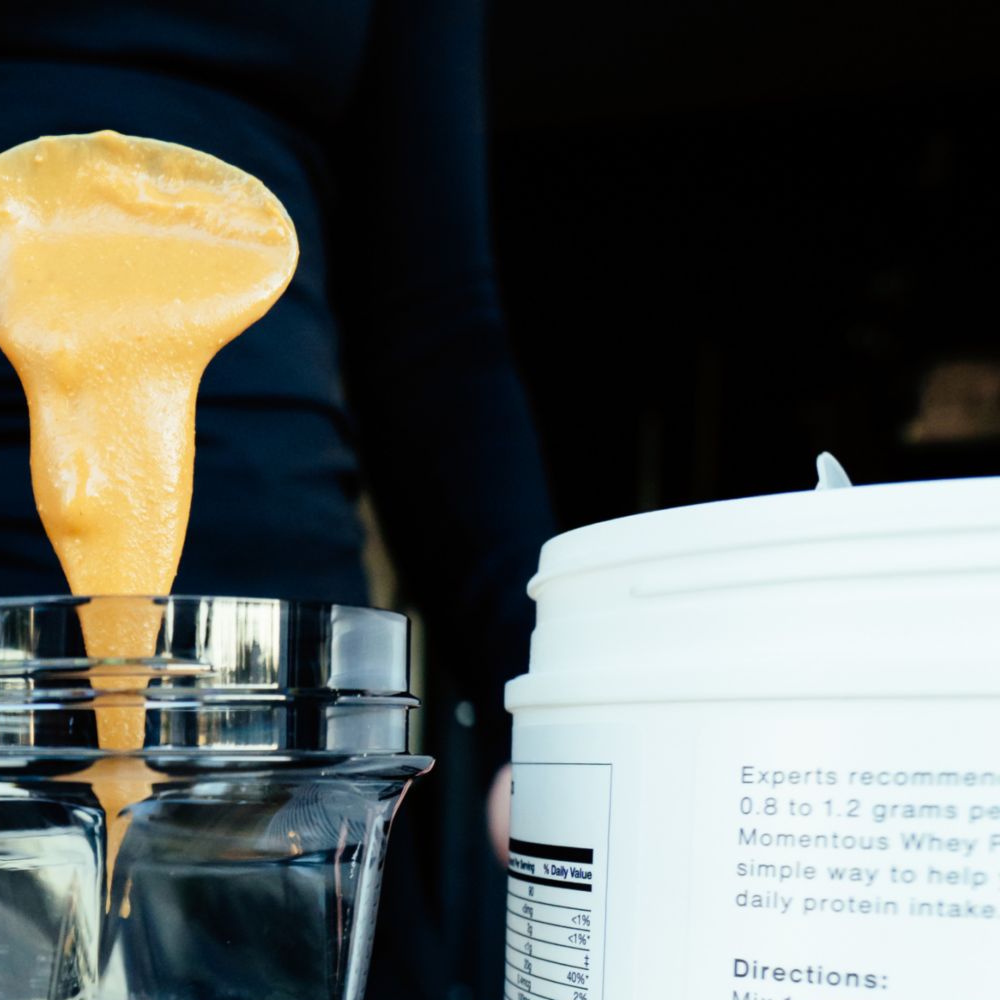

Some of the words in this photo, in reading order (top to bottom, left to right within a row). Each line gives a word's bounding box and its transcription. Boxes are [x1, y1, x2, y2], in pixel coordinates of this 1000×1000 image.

[741, 766, 838, 788] Experts
[740, 797, 777, 816] 0.8
[789, 800, 812, 816] to
[825, 799, 861, 818] 1.2
[872, 803, 958, 823] grams
[738, 828, 889, 850] Momentous
[901, 832, 978, 857] Whey
[551, 864, 568, 880] Daily
[570, 867, 592, 880] Value
[737, 860, 816, 882] simple
[827, 866, 878, 886] way
[891, 867, 916, 884] to
[927, 866, 988, 888] help
[735, 890, 792, 914] daily
[803, 896, 898, 915] protein
[571, 914, 591, 927] <1%
[733, 958, 888, 989] Directions:
